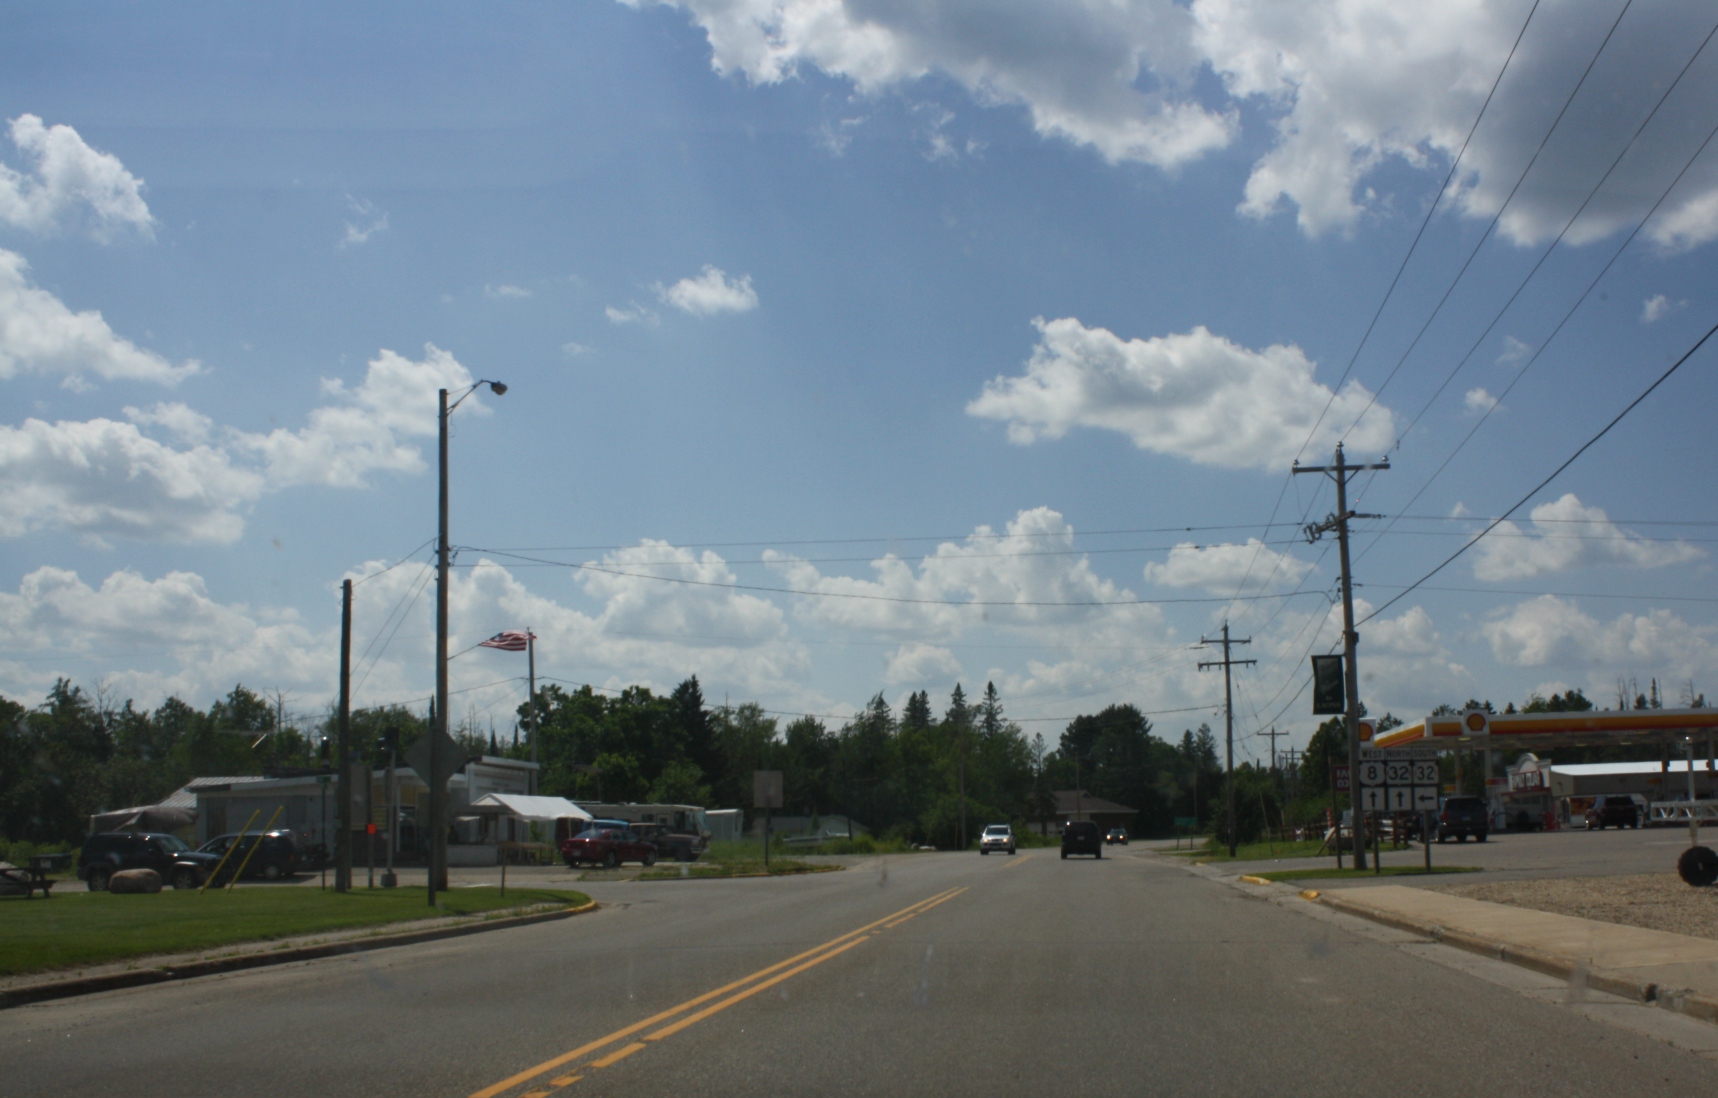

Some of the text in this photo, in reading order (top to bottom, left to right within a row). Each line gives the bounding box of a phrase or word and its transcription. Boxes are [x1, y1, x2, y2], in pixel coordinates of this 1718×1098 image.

[1361, 749, 1382, 757] WEST
[1386, 749, 1411, 757] NORTH
[1413, 749, 1437, 757] SOUTH
[1367, 765, 1377, 780] 8
[1388, 765, 1409, 780] 32
[1417, 765, 1435, 780] 32
